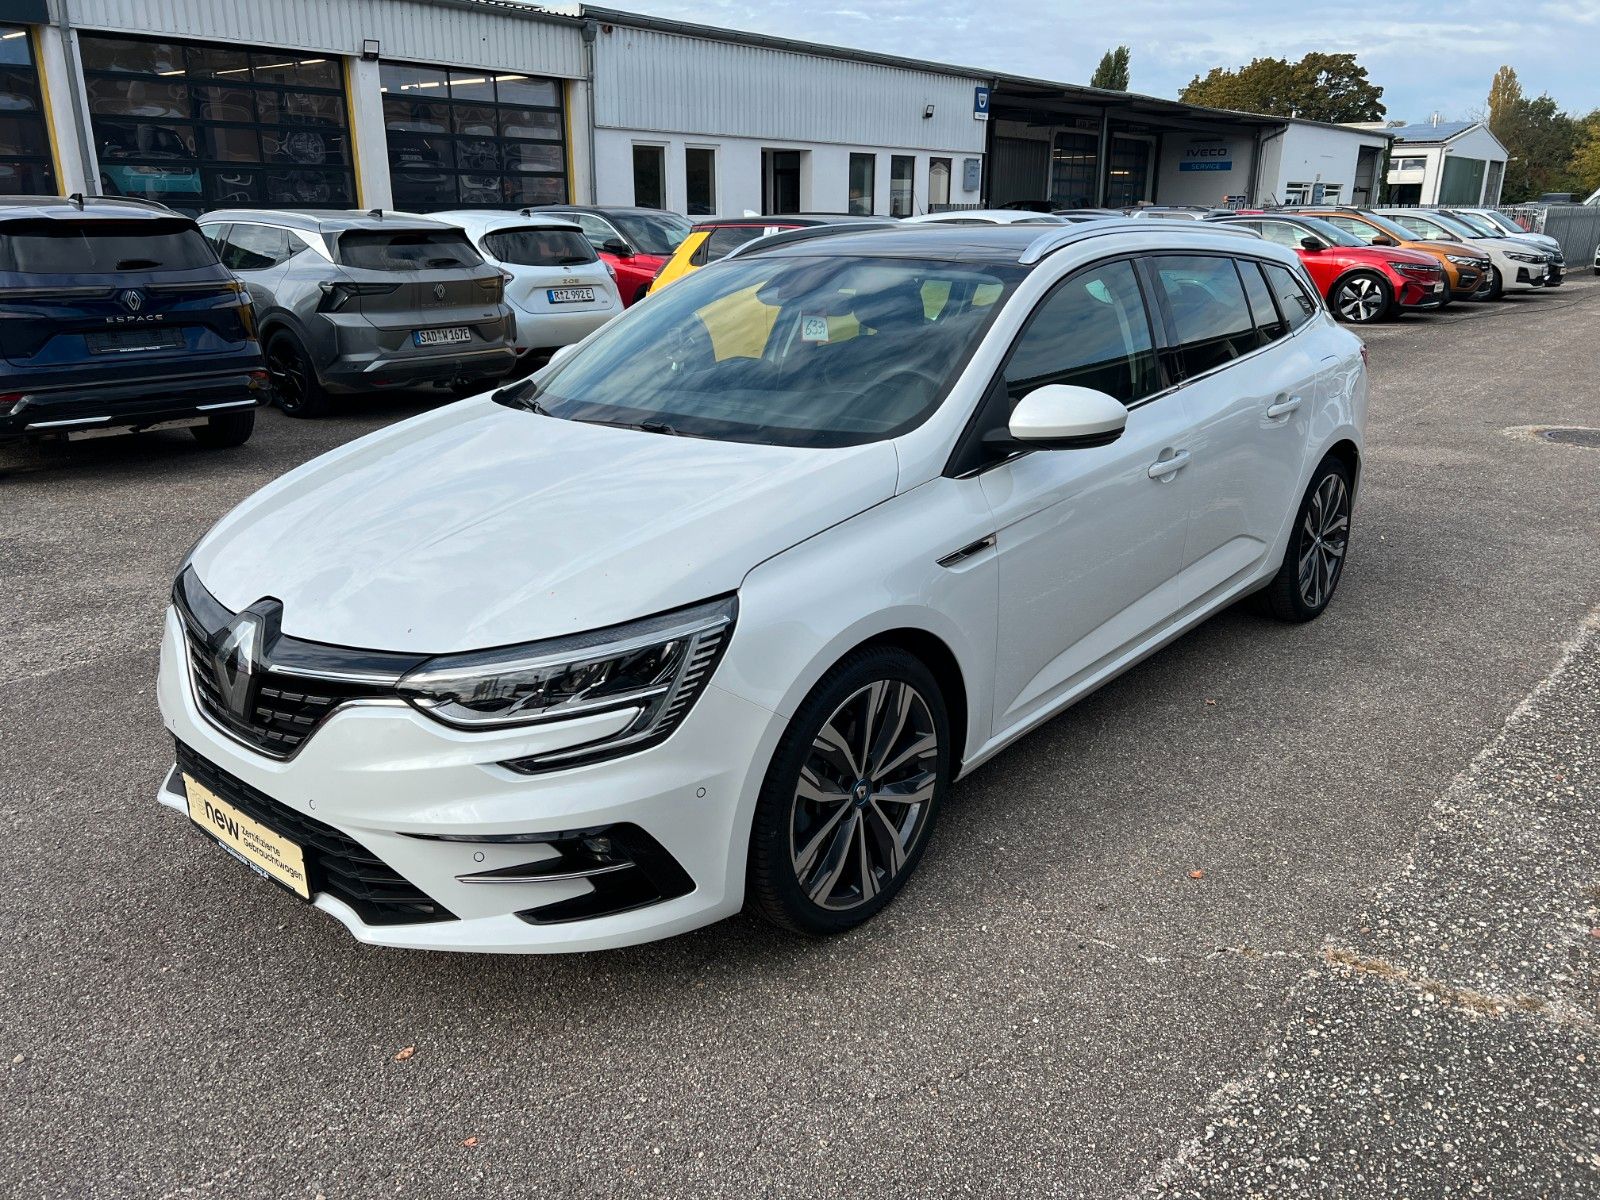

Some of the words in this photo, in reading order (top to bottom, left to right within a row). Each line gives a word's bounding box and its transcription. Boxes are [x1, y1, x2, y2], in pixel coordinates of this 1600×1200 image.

[1186, 148, 1228, 157] IVECO
[554, 291, 561, 300] R
[105, 314, 164, 323] ESPACE
[420, 329, 437, 343] SAD
[449, 328, 470, 341] 167E
[240, 825, 281, 857] Zertifizierte
[243, 837, 304, 882] Gebrauchtwagen
